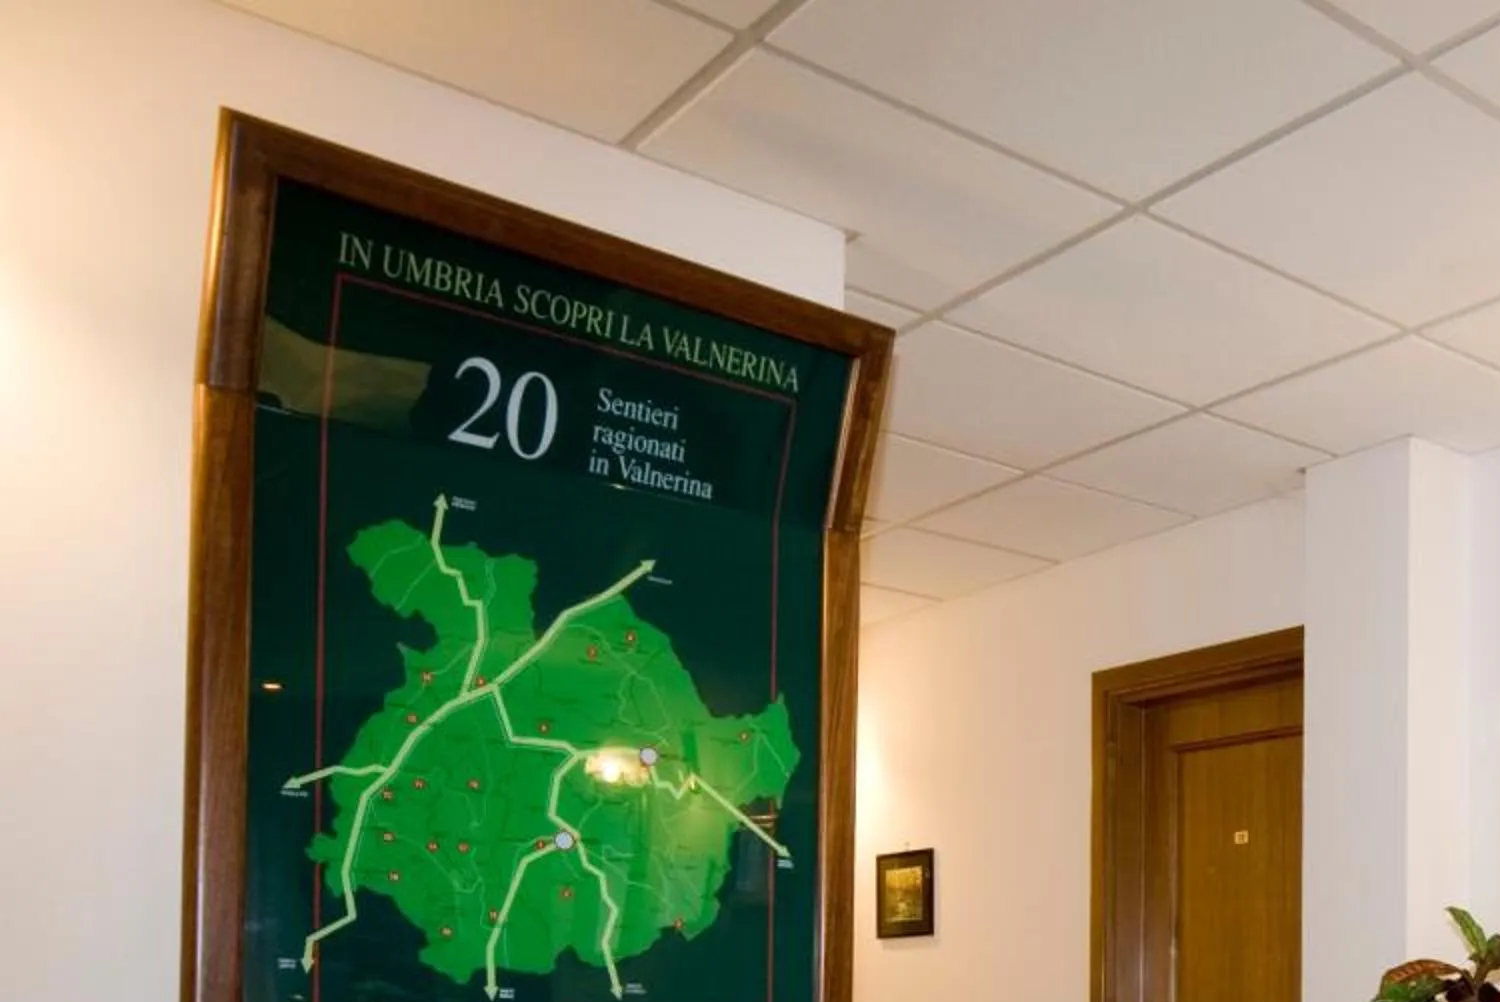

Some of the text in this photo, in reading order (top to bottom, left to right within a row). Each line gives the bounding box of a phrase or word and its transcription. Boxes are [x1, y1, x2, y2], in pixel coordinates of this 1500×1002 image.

[339, 231, 800, 393] IN UMBRIA SCOPRI LA VALNERINA
[447, 356, 558, 460] 20
[596, 387, 680, 431] Sentieri
[592, 424, 687, 463] ragionati
[588, 449, 714, 500] in Valnerina
